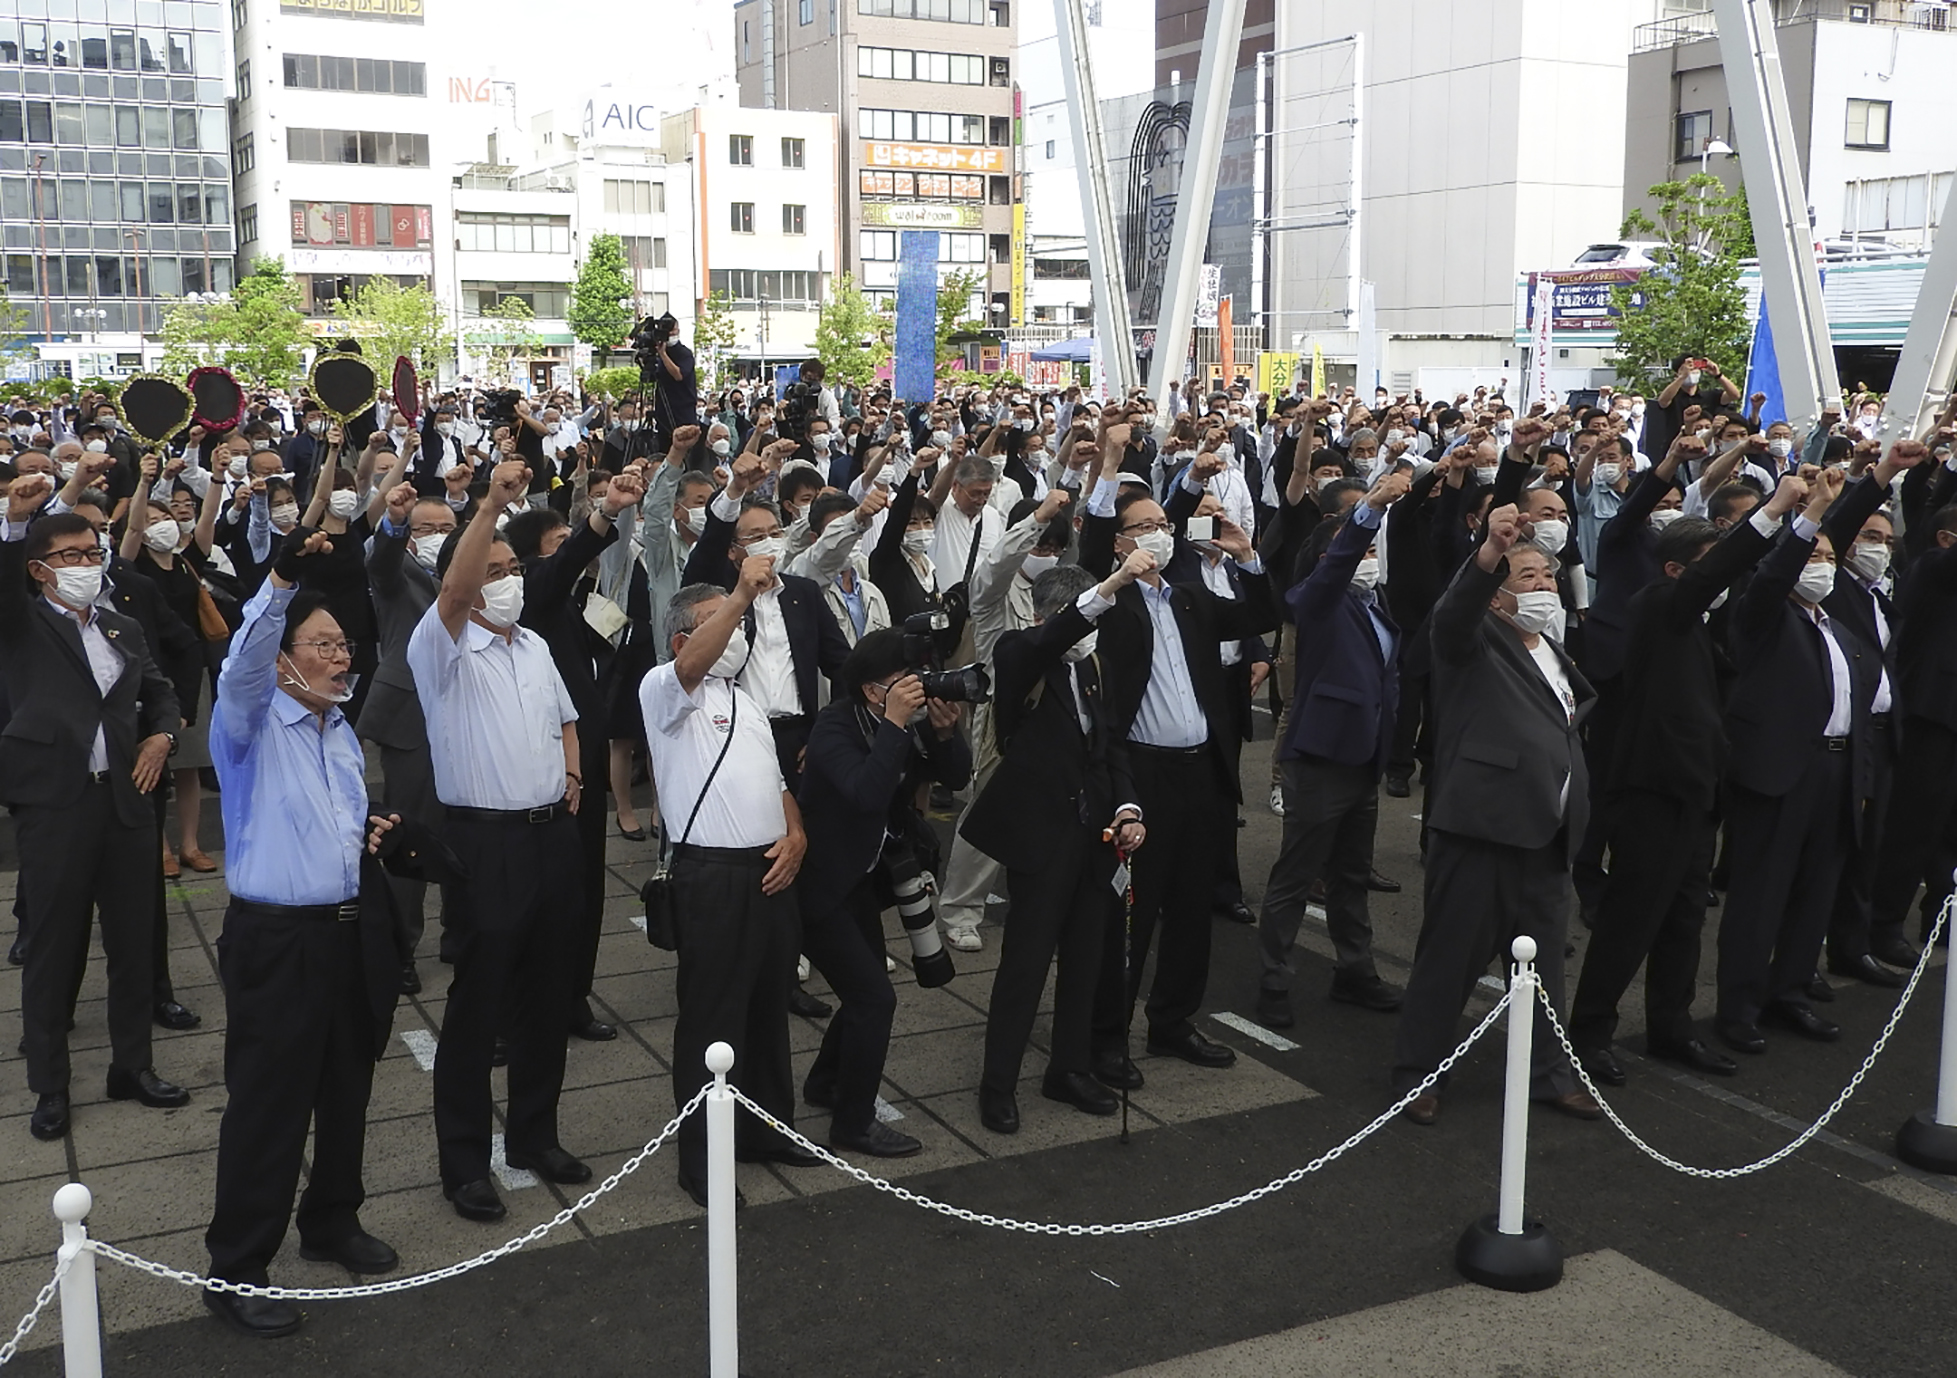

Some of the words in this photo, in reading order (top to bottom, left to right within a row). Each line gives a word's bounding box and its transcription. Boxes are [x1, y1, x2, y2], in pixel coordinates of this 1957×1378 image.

[449, 77, 490, 102] ING
[602, 103, 655, 131] AIC
[893, 146, 966, 167] キャネット
[969, 151, 997, 169] 4F
